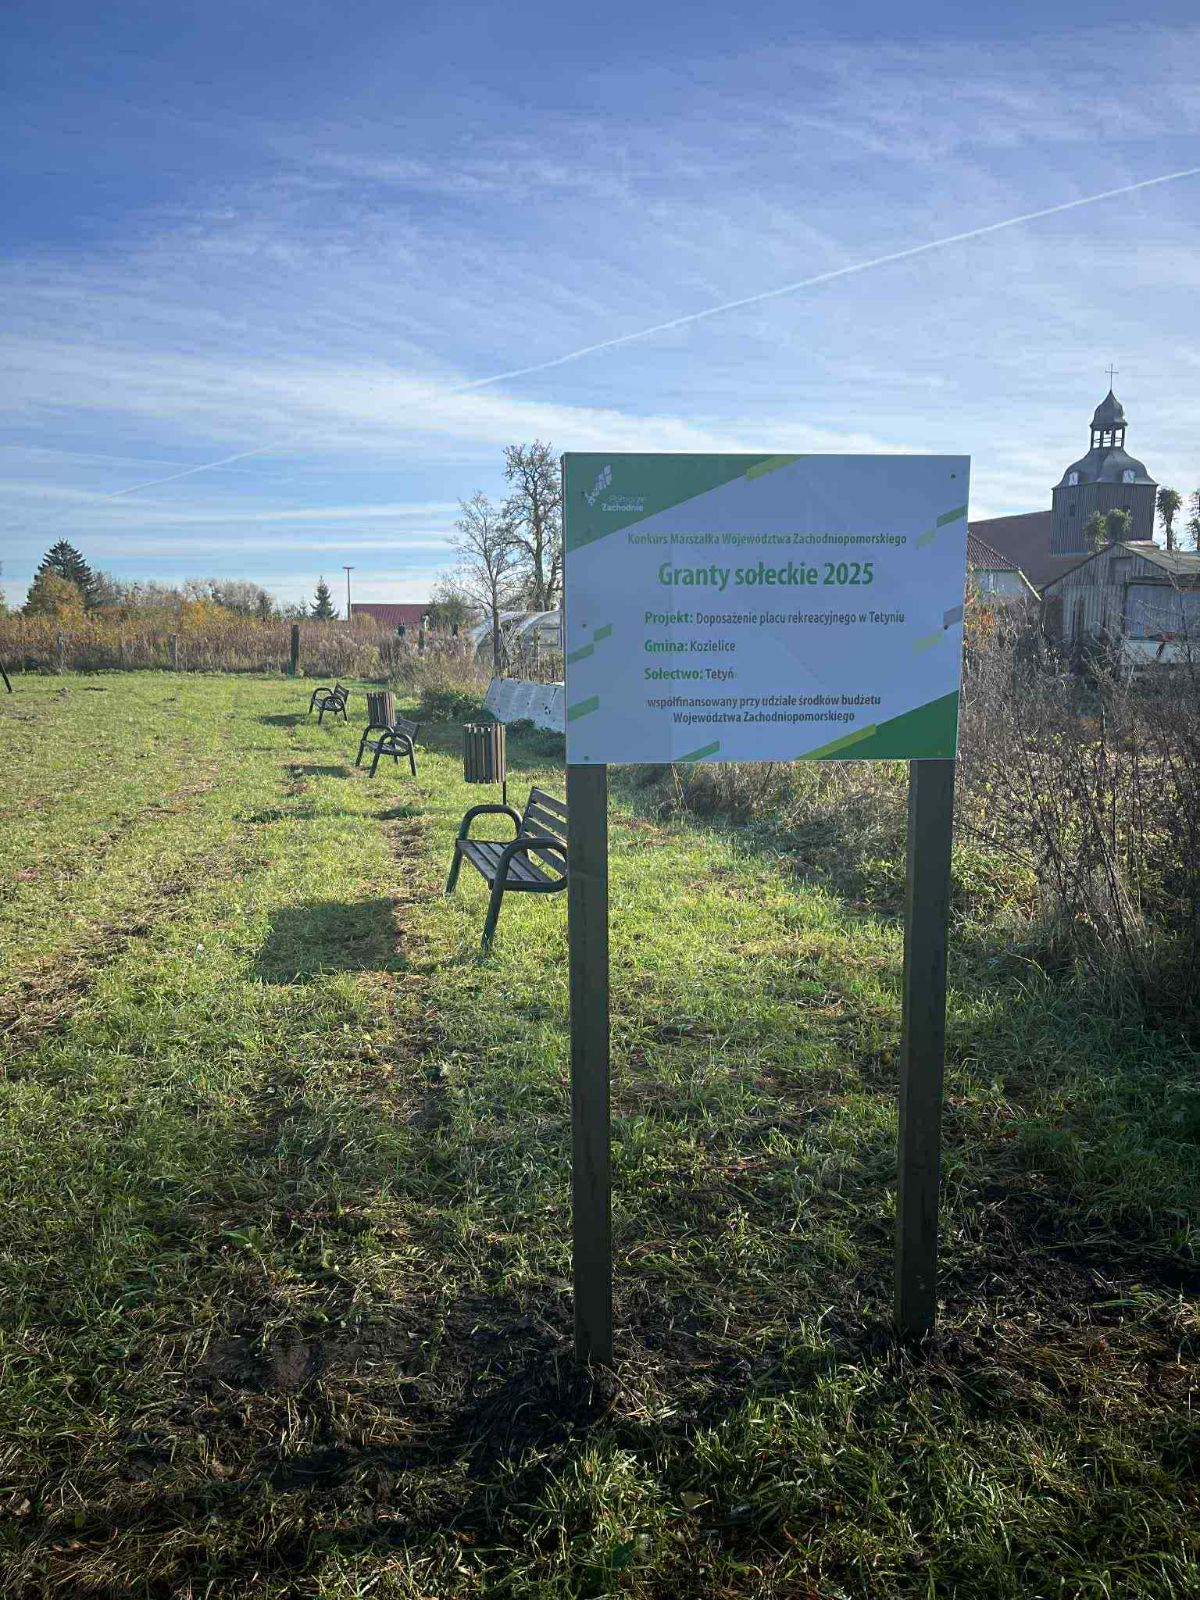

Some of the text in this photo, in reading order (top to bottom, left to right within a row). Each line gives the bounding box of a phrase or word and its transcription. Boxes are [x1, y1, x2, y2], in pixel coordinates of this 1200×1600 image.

[602, 503, 644, 512] Zachodnie
[628, 533, 668, 545] Konkurs
[671, 533, 720, 545] Marszałka
[793, 533, 907, 547] Zachodniopomorskiego
[658, 561, 874, 592] Granty sołeckie 2025
[645, 610, 905, 626] Projekt: Doposażenie placu rekreacyjnego w Tetyniu
[644, 640, 736, 652] Gmina: Kozielice
[644, 667, 734, 681] Sołectwo: Tetyń
[648, 693, 881, 710] współfinansowany przy udziale środków budżetu
[674, 710, 855, 725] Województwa Zachodniopomorskiego
